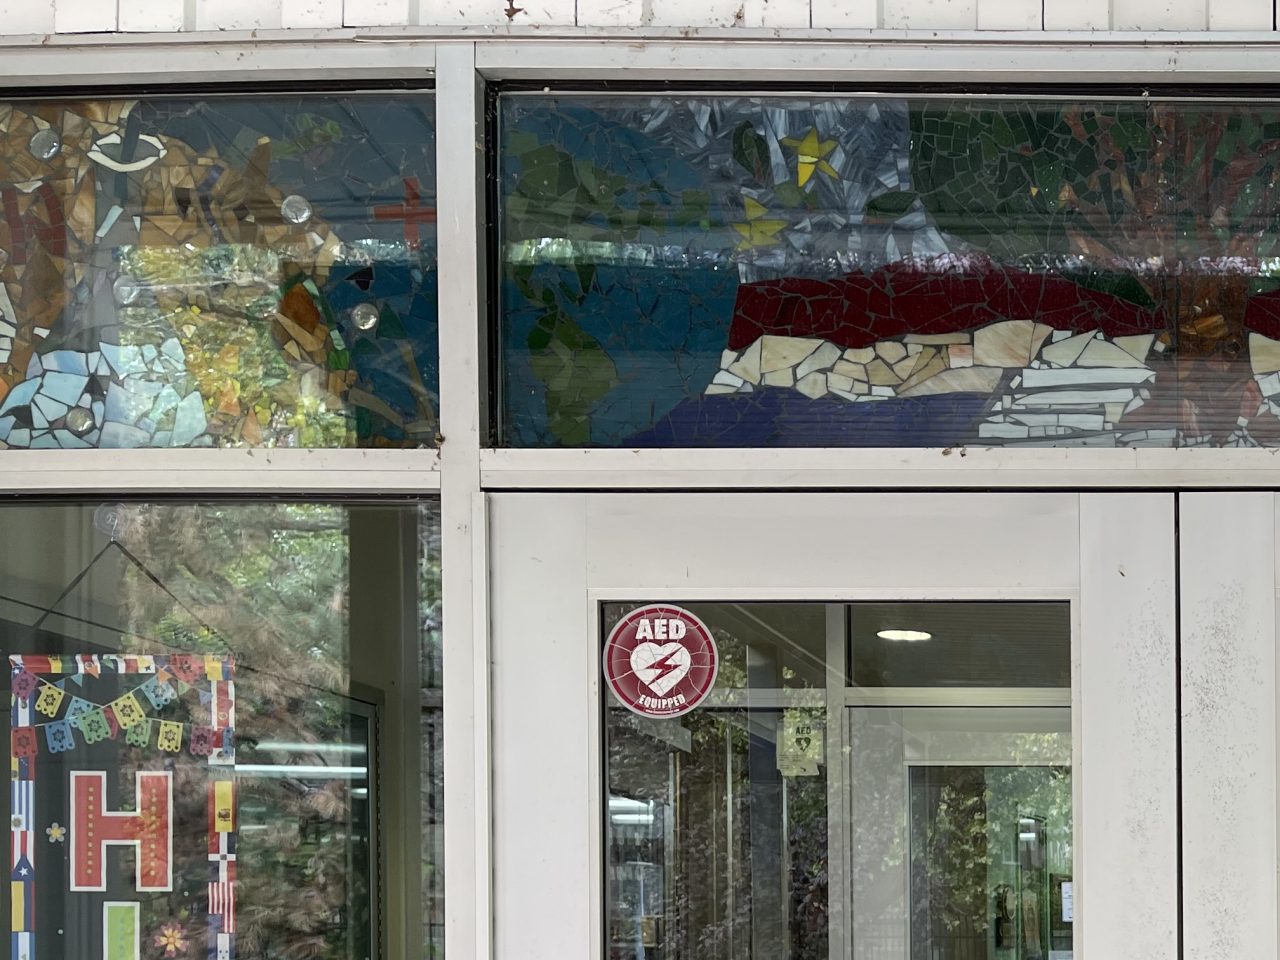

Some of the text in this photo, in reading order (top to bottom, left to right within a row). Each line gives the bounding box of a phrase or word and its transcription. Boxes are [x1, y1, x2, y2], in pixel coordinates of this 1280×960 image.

[635, 618, 687, 640] AED
[638, 693, 686, 709] EQUIPPED
[796, 726, 811, 735] AED
